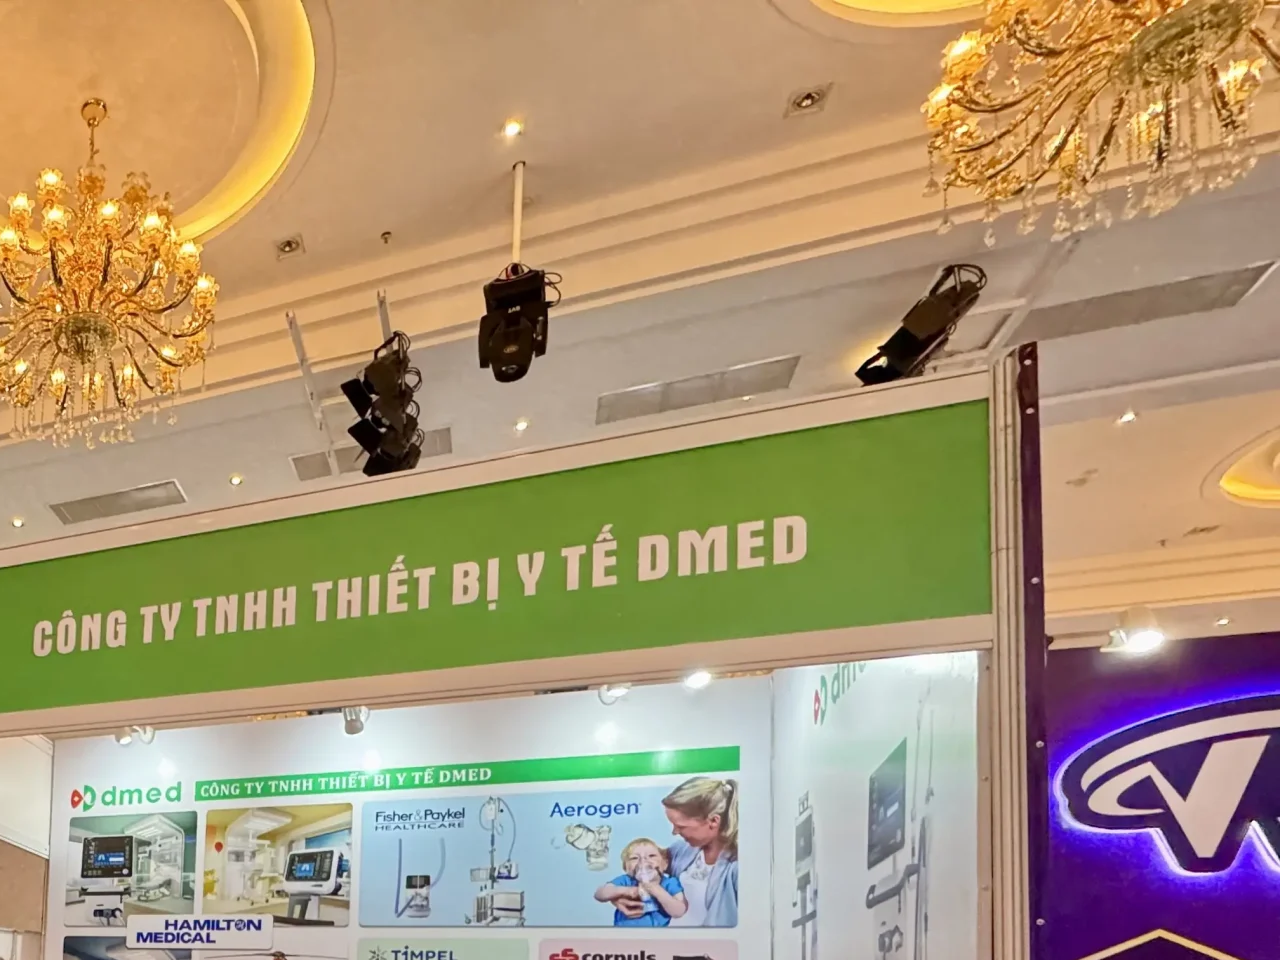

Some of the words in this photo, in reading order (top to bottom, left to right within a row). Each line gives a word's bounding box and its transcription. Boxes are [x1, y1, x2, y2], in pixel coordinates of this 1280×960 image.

[32, 609, 127, 657] CÔNG
[140, 602, 182, 644] TY
[193, 586, 297, 637] TNHH
[312, 555, 437, 622] THIẾT
[452, 557, 500, 611] BỊ
[517, 551, 545, 597] Y
[561, 523, 618, 591] TẾ
[637, 515, 808, 582] DMED
[200, 781, 241, 797] CÔNG
[244, 781, 265, 794] TY
[268, 777, 313, 793] TNHH
[318, 772, 369, 790] THIẾT
[373, 775, 390, 789] BỊ
[395, 773, 408, 786] Y
[412, 767, 435, 785] TẾ
[439, 767, 492, 784] DMED
[101, 781, 182, 806] dmed
[550, 801, 640, 819] Aerogen
[375, 821, 465, 832] HEALTHCARE
[164, 919, 262, 931] HAMILTON
[136, 932, 216, 943] MEDICAL
